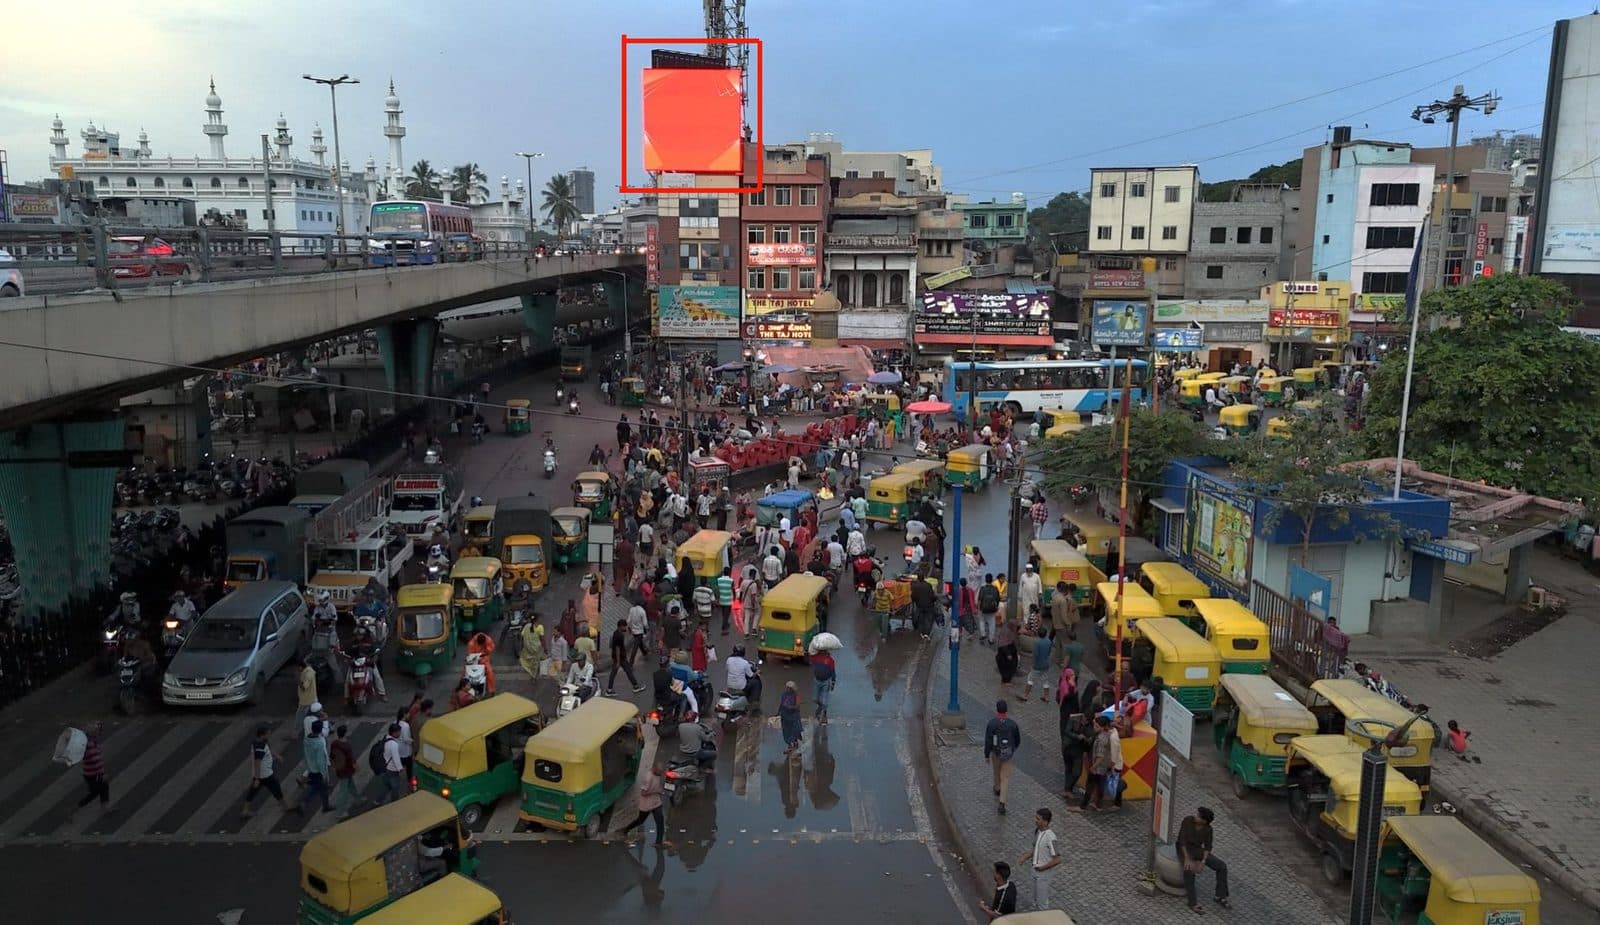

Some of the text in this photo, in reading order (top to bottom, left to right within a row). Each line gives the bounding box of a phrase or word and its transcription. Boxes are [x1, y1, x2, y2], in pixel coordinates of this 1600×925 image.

[1477, 224, 1486, 256] LODGE
[648, 233, 656, 281] ROOMS
[1285, 284, 1318, 292] WINES
[770, 300, 784, 308] TAJ
